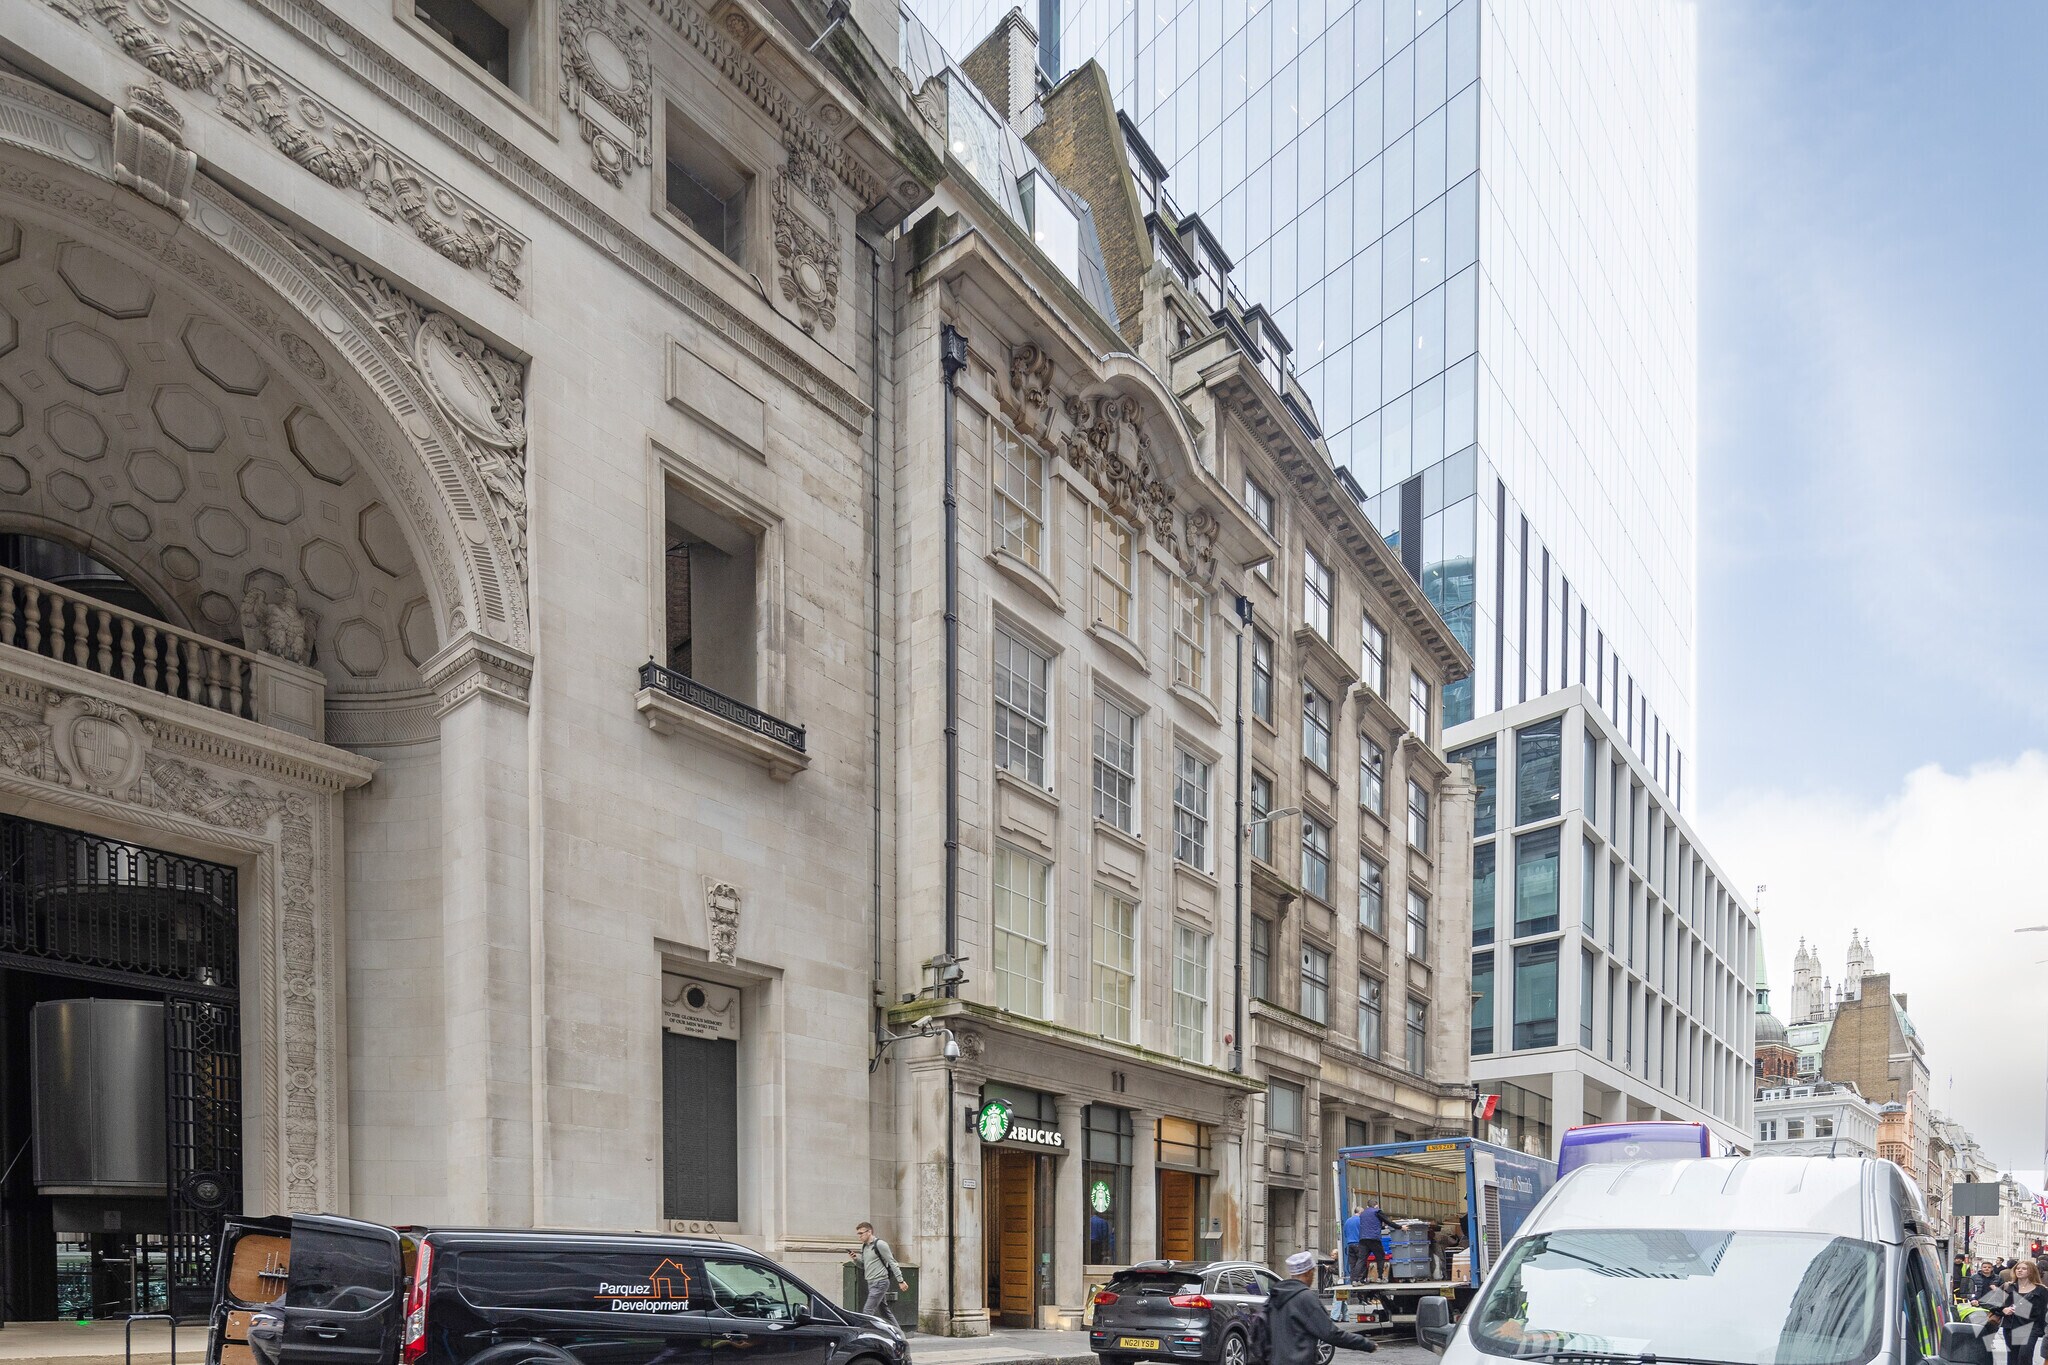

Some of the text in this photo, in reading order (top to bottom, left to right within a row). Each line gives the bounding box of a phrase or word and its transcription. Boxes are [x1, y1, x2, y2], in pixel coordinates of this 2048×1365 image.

[681, 1015, 703, 1023] GLORIOUS
[1008, 1126, 1062, 1146] RBUCKS
[599, 1282, 650, 1297] Parquez
[611, 1299, 689, 1313] Development
[1124, 1338, 1155, 1348] NG21 YSB
